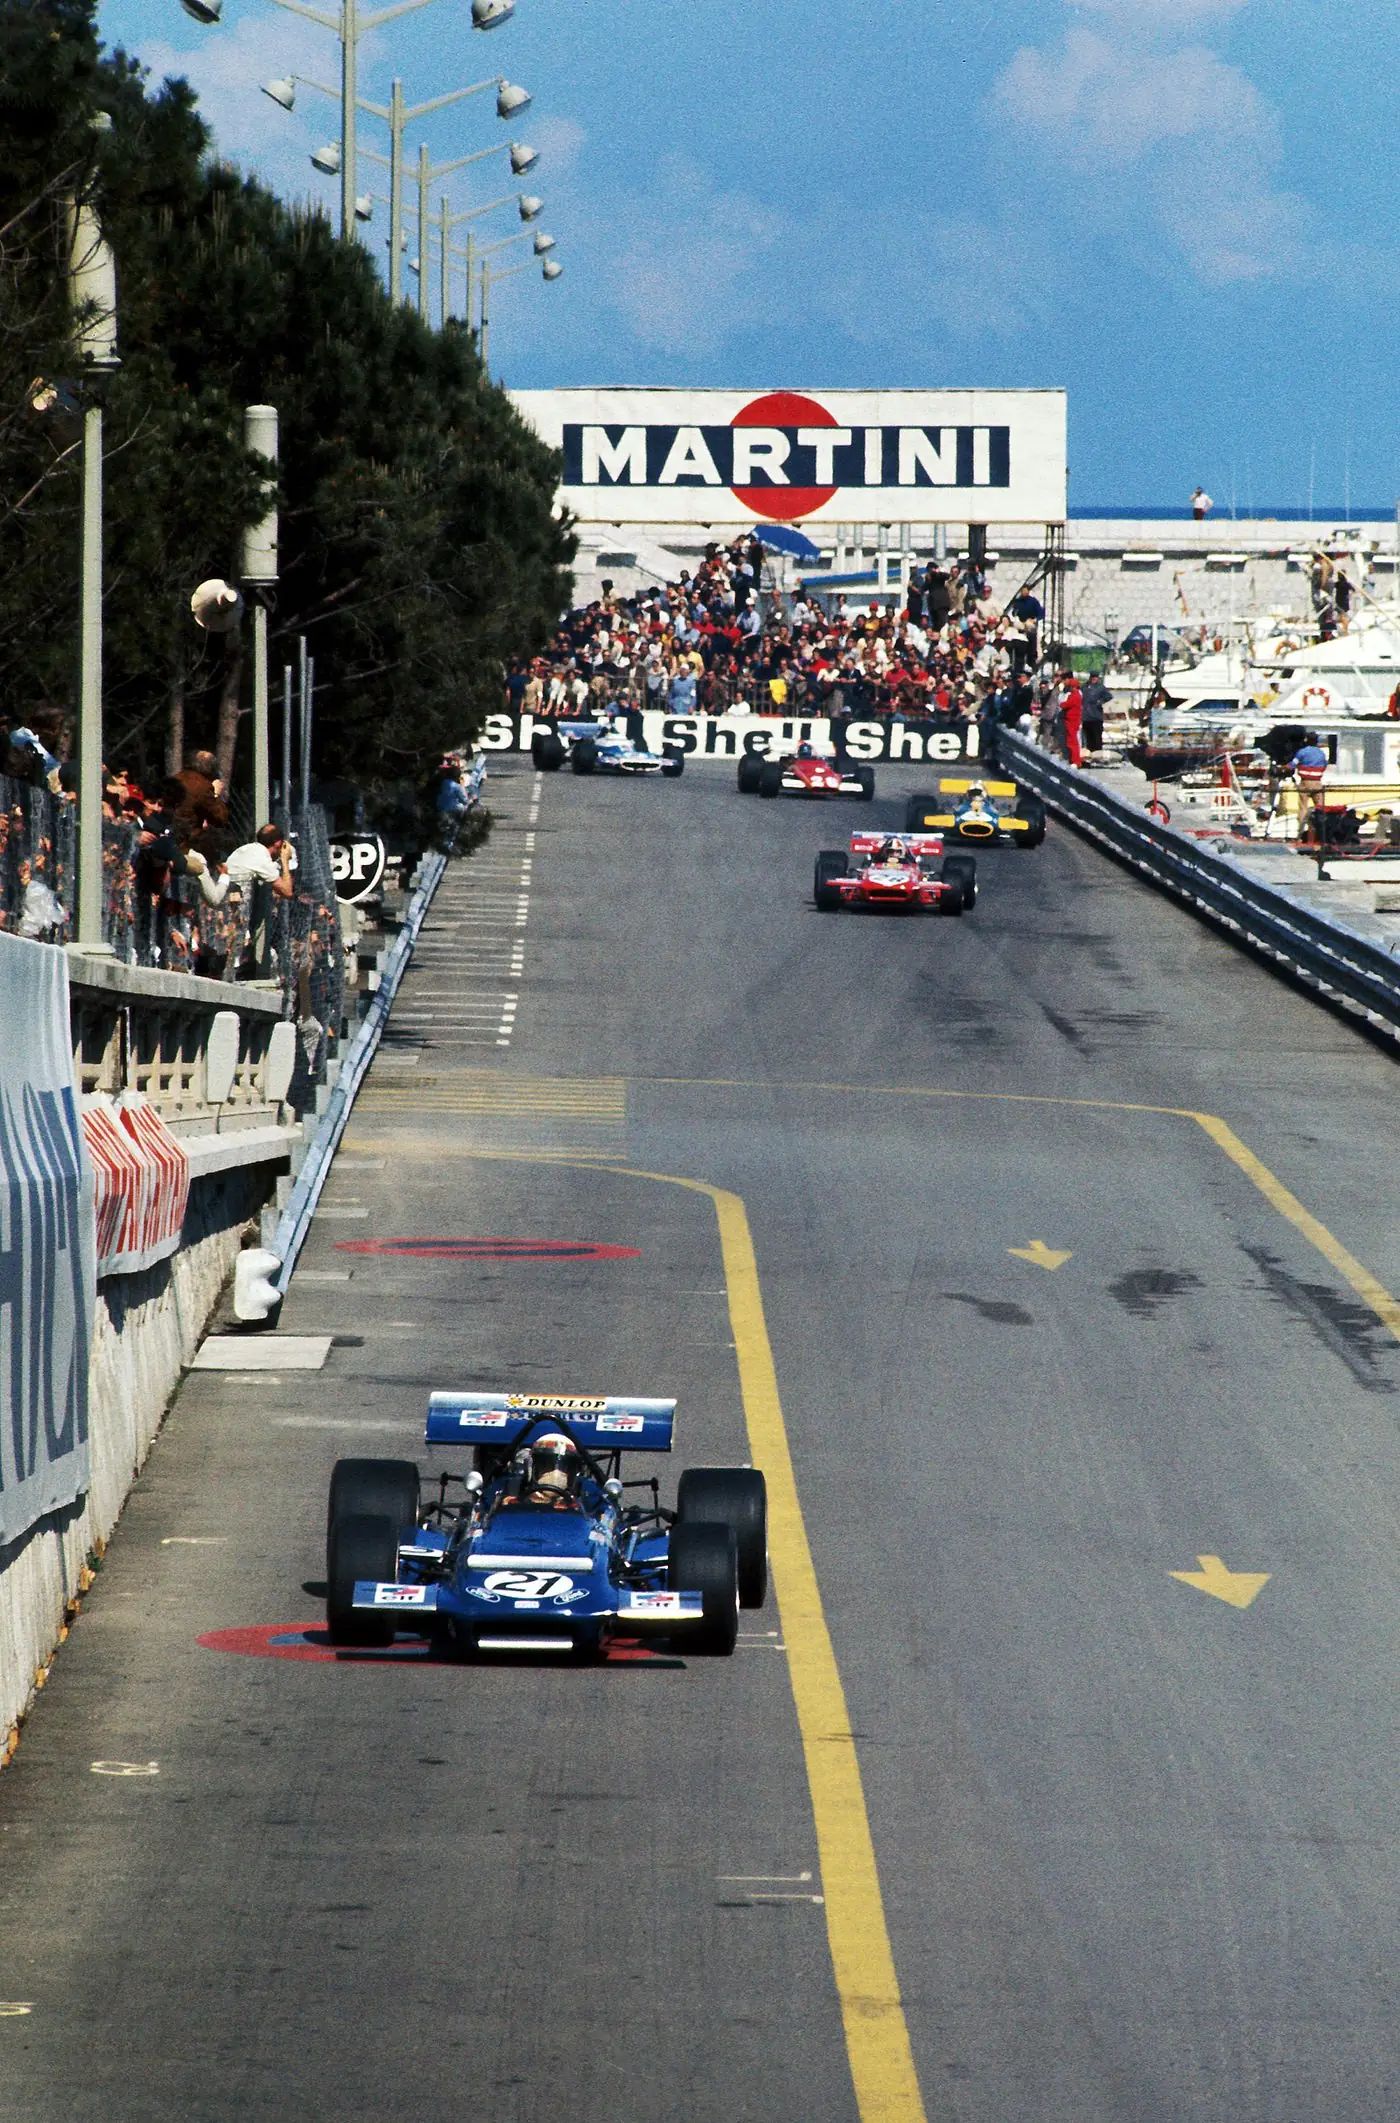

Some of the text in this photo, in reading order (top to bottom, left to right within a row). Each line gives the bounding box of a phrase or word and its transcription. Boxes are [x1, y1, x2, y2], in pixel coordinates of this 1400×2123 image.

[582, 426, 990, 485] MARTINI
[845, 721, 980, 760] Shel
[329, 843, 377, 880] BP
[527, 1398, 605, 1409] DUNLOP
[492, 1573, 561, 1595] 21
